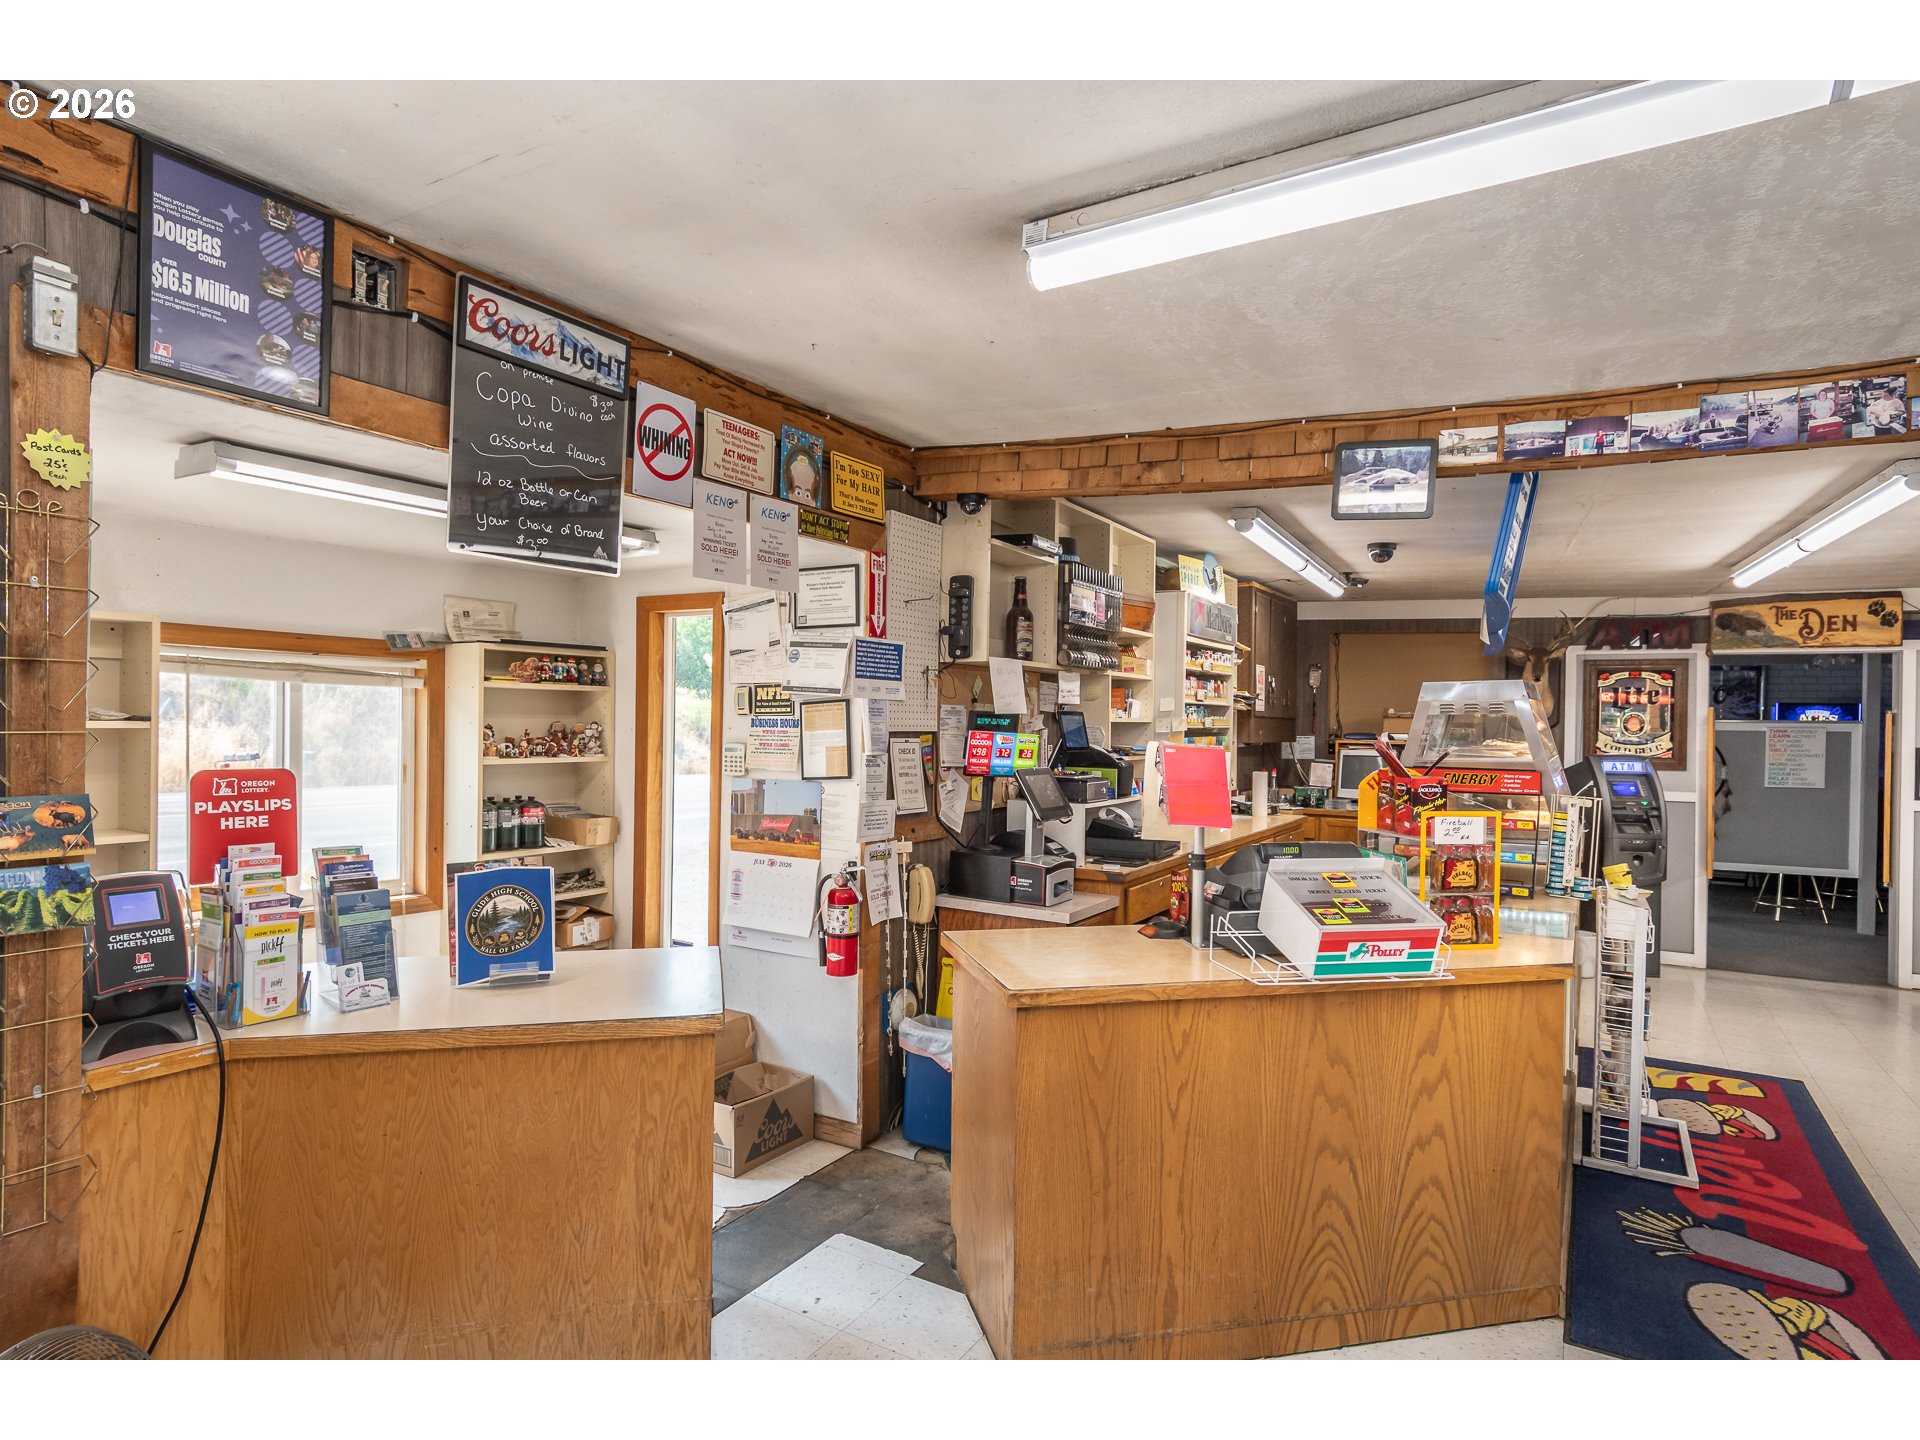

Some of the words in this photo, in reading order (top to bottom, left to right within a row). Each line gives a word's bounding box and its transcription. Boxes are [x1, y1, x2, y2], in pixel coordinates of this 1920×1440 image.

[153, 192, 172, 202] When
[173, 199, 185, 208] you
[186, 204, 200, 213] play
[153, 198, 177, 210] Oregon
[178, 206, 201, 219] Lottery
[152, 203, 166, 212] you
[166, 208, 180, 217] help
[182, 214, 216, 230] contribute
[153, 212, 222, 258] Douglas
[162, 258, 178, 267] OVER
[198, 253, 226, 268] COUNTY
[152, 260, 192, 296] $16.5
[195, 276, 250, 314] Million
[164, 300, 196, 314] programs
[196, 308, 212, 318] right
[212, 314, 227, 323] here
[174, 298, 200, 310] support
[200, 306, 222, 316] places
[468, 294, 557, 356] Coors
[560, 338, 626, 381] LIGHT
[150, 354, 174, 364] OREGON
[500, 361, 514, 372] on
[522, 368, 554, 386] premise
[476, 372, 536, 410] Copa
[518, 414, 554, 431] Wine
[722, 420, 760, 441] TEENAGERS:
[30, 441, 54, 452] Post
[55, 446, 81, 456] Cards
[490, 433, 555, 454] assorted
[566, 443, 606, 466] flavors
[640, 424, 690, 460] WHINING
[732, 440, 744, 450] Stupid
[724, 448, 736, 458] ACT
[836, 460, 846, 472] I'm
[848, 464, 859, 476] Too
[861, 468, 880, 484] SEXY
[477, 470, 492, 486] 12
[498, 479, 514, 489] oz
[520, 478, 554, 496] Bottle
[559, 488, 571, 497] or
[573, 489, 598, 504] Can
[836, 474, 847, 486] For
[849, 479, 859, 492] My
[862, 483, 880, 496] HAIR
[518, 492, 548, 508] Beer
[706, 493, 736, 509] KENO
[839, 490, 854, 501] That's
[761, 507, 788, 522] KENO
[858, 504, 875, 514] THERE
[476, 513, 510, 532] Your
[518, 516, 553, 534] Choice
[560, 524, 571, 535] of
[574, 524, 604, 540] Brand
[802, 511, 817, 522] DON'T
[819, 516, 829, 526] ACT
[832, 519, 848, 530] STUPID
[703, 537, 722, 545] WINNING
[701, 543, 718, 553] SOLD
[720, 546, 738, 557] HERE!
[756, 554, 772, 563] SOLD
[773, 558, 792, 567] HERE!
[873, 559, 884, 571] FIRE
[1181, 572, 1200, 586] SPIRIT
[1205, 604, 1232, 634] Marlboro
[1769, 605, 1798, 626] THE
[1798, 608, 1858, 642] DEN
[1593, 620, 1692, 649] ATM
[751, 718, 779, 728] BUSINESS
[780, 718, 799, 728] HOURS
[972, 748, 987, 756] 498
[1604, 743, 1631, 753] COLD
[1442, 772, 1498, 785] ENERGY
[194, 798, 292, 815] PLAYSLIPS
[220, 815, 269, 830] HERE
[761, 818, 790, 828] Budweiser
[1452, 871, 1473, 880] FIREBALL
[1172, 882, 1188, 892] 100%
[472, 896, 491, 918] GLIDE
[491, 888, 513, 898] HIGH
[514, 889, 539, 912] SCHOOL
[109, 931, 142, 942] CHECK
[144, 928, 172, 938] YOUR
[1451, 923, 1470, 933] FIREBALL
[107, 940, 148, 950] TICKETS
[150, 935, 175, 944] HERE
[511, 940, 530, 951] FAME
[1366, 944, 1405, 957] POLLEY
[756, 1116, 795, 1144] Coors
[760, 1133, 788, 1152] LIGHT
